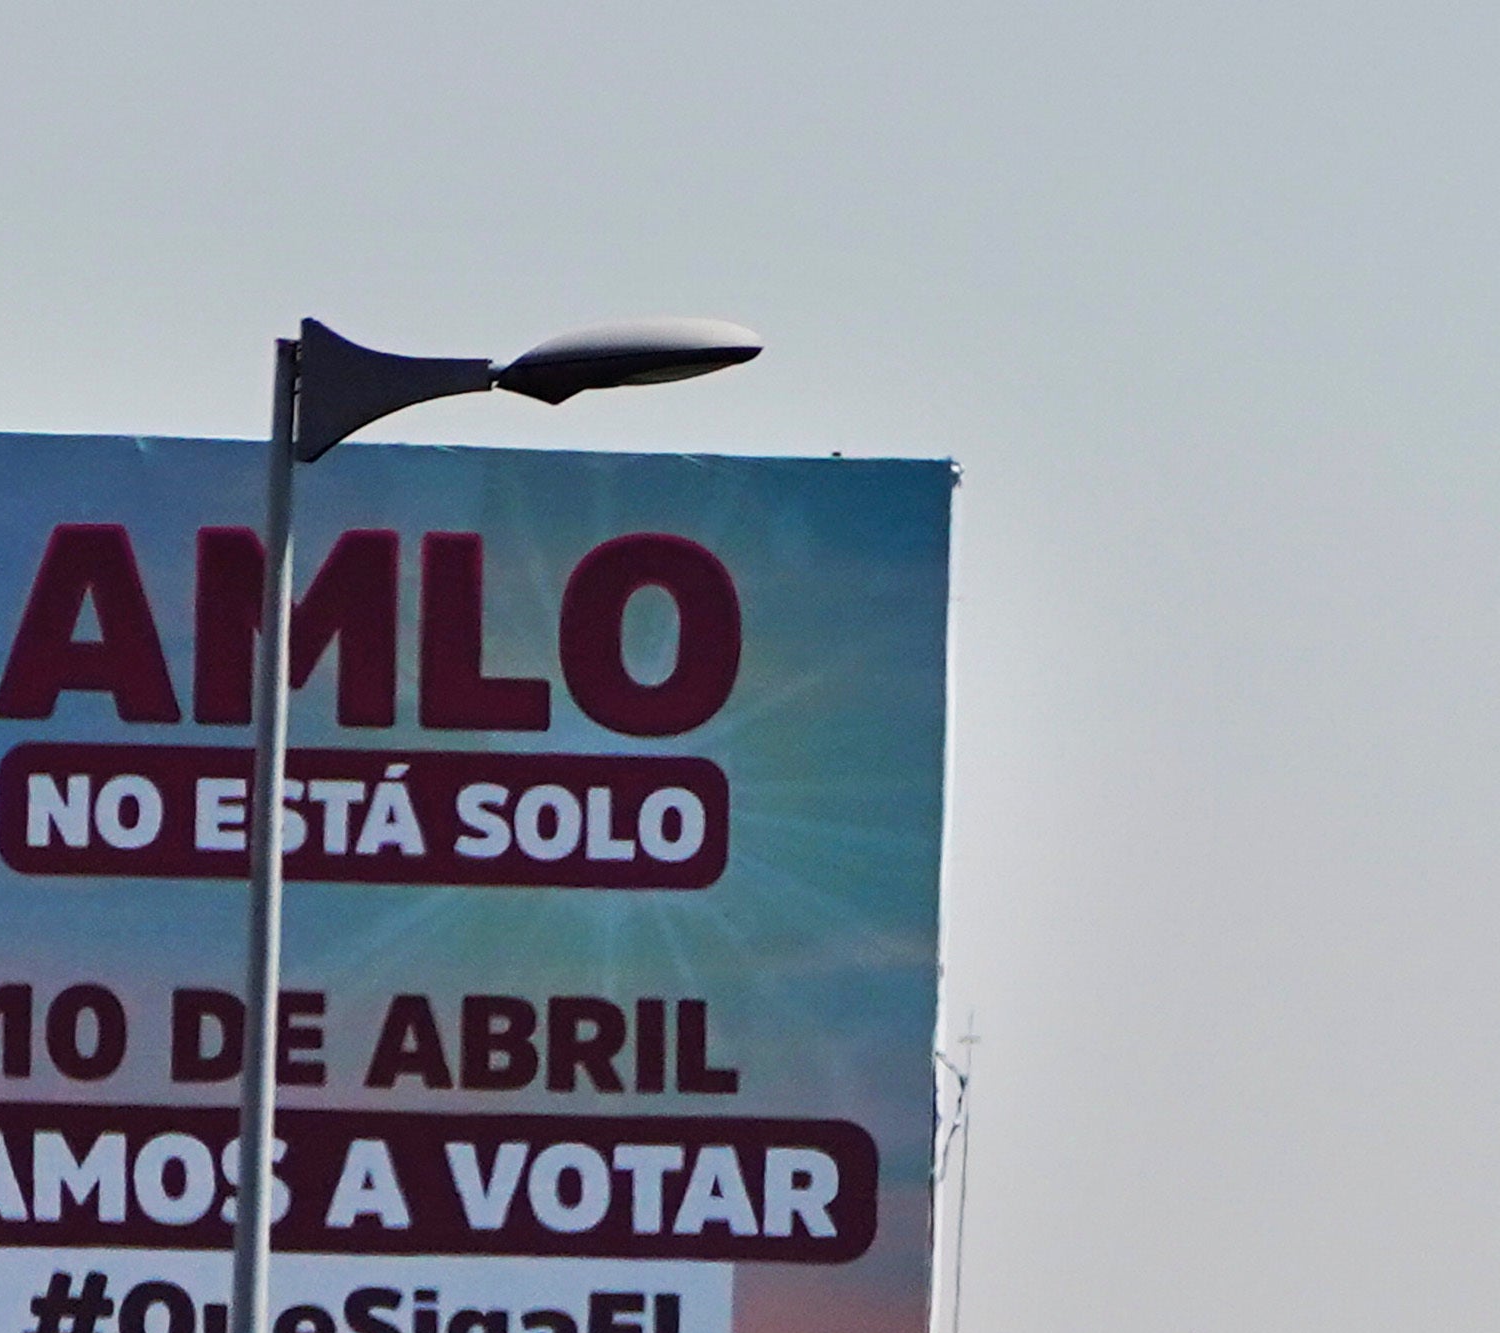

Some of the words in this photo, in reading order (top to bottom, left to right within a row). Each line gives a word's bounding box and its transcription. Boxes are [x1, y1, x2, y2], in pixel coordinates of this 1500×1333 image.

[24, 773, 164, 851] NO
[453, 781, 707, 863] SOLO
[170, 986, 328, 1087] DE
[362, 993, 740, 1096] ABRIL
[324, 1138, 411, 1230] A
[445, 1139, 840, 1240] VOTAR
